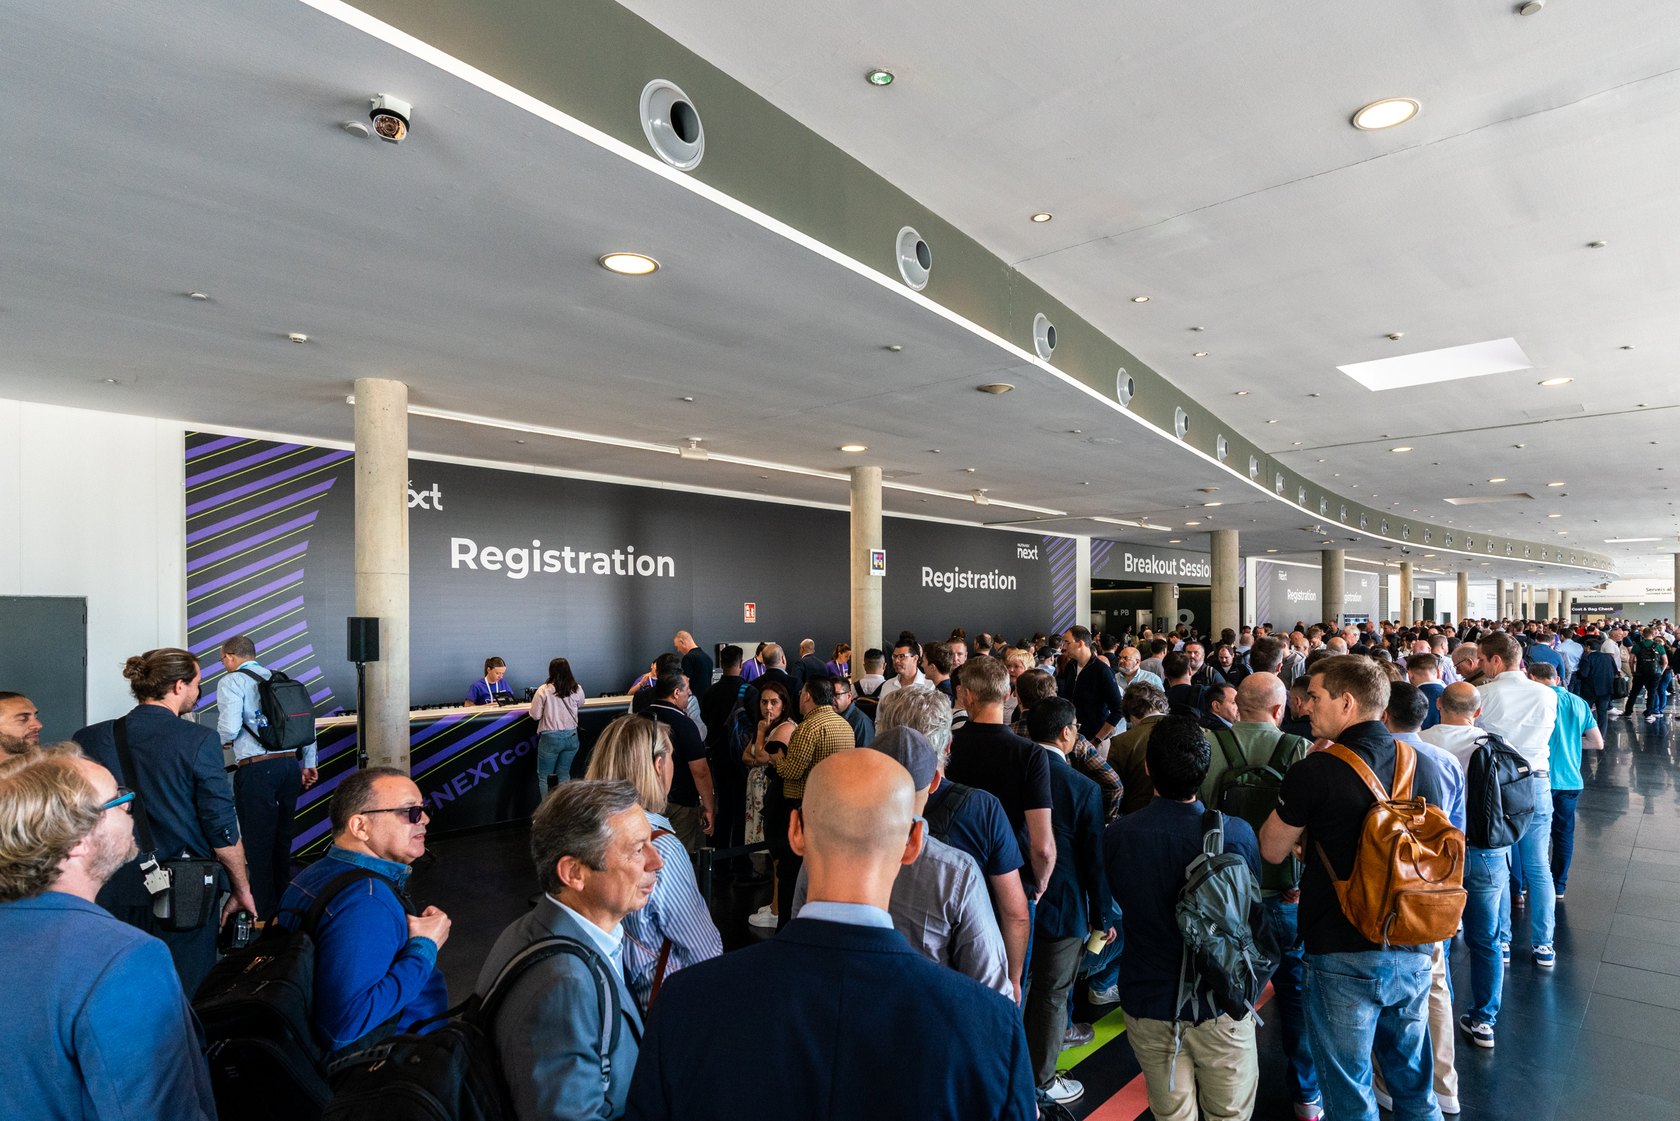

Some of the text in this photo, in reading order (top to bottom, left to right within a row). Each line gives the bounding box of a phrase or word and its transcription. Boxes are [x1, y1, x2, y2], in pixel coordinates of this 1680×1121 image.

[408, 483, 443, 511] xt
[451, 537, 675, 579] Registration
[1017, 545, 1038, 560] next
[1124, 552, 1177, 575] Breakout
[1180, 558, 1211, 578] Sessio
[922, 566, 1016, 593] Registration
[1287, 588, 1317, 603] Registration
[1344, 591, 1362, 604] gistration
[1120, 608, 1129, 616] PB
